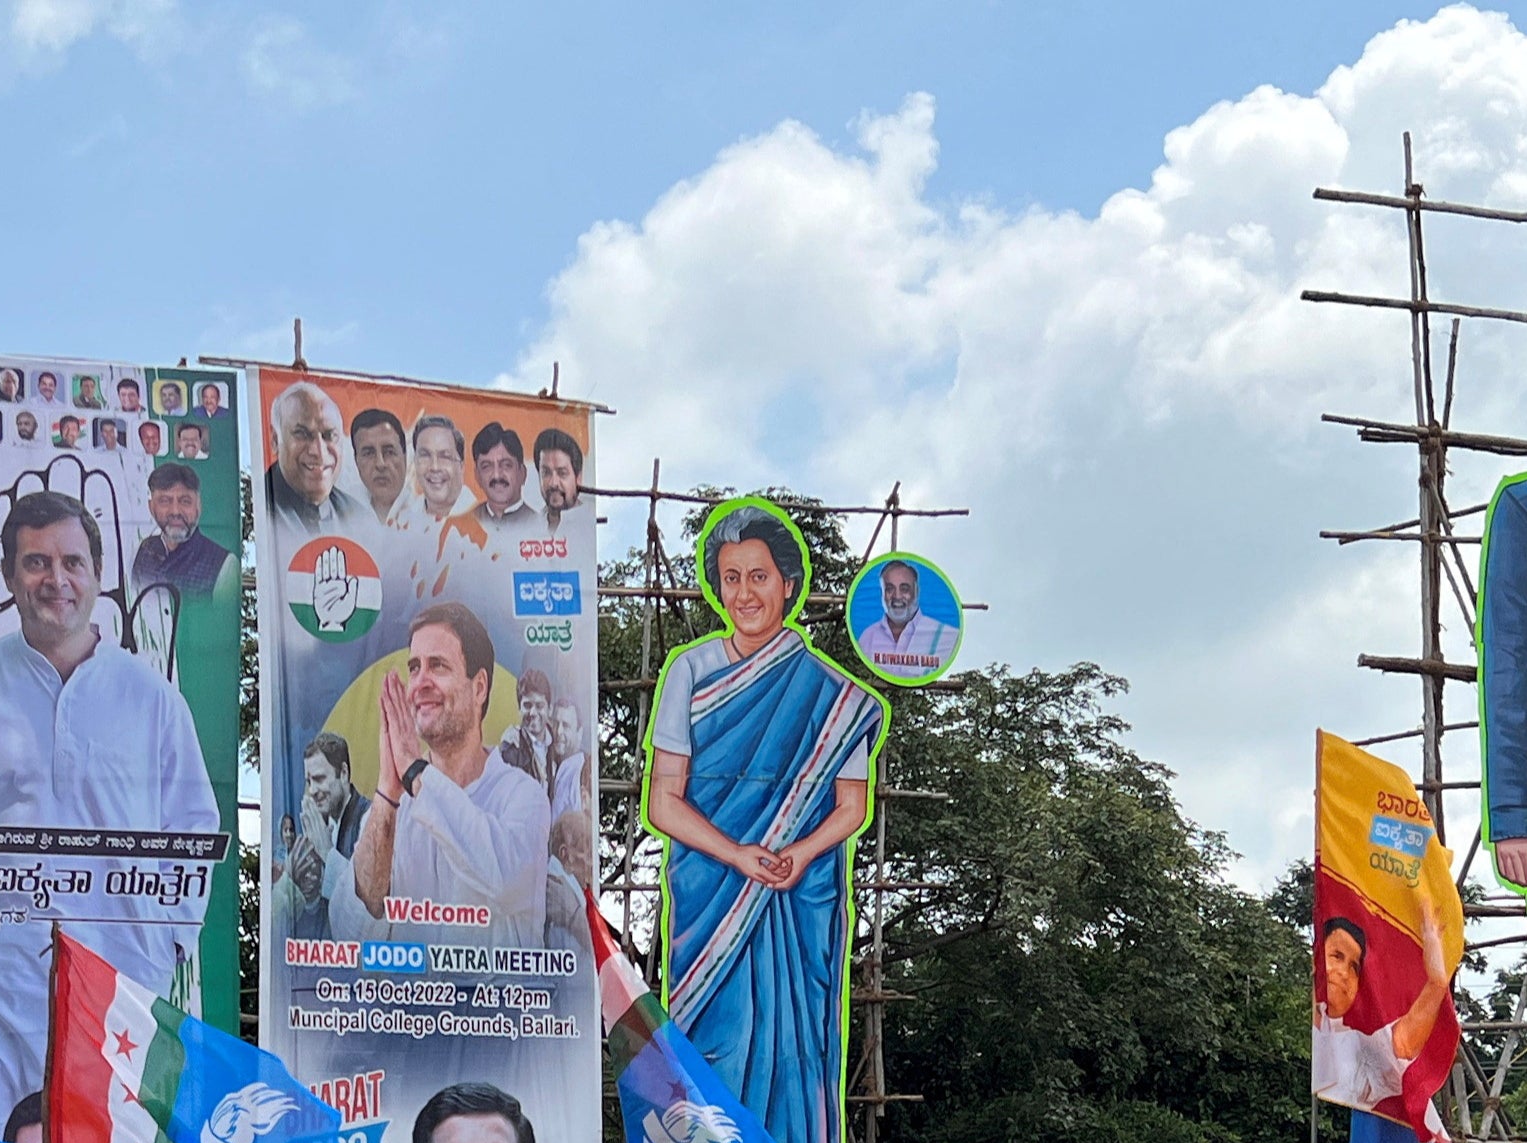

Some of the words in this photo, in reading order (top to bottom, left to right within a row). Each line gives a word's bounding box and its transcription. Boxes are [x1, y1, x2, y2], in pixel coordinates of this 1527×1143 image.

[519, 537, 569, 562] ಭಾರತ
[386, 899, 489, 925] Welcome
[287, 941, 358, 965] BHARAT
[364, 945, 423, 968] JODO
[431, 947, 489, 971] YATRA
[495, 950, 575, 974] MEETING
[318, 981, 350, 1000] On:
[354, 981, 374, 999] 15
[379, 983, 410, 1002] Oct
[414, 984, 456, 1003] 2022
[473, 985, 500, 1004] At:
[505, 986, 548, 1010] 12pm
[370, 1012, 434, 1036] College
[439, 1013, 518, 1039] Grounds,
[523, 1016, 580, 1038] Ballari.
